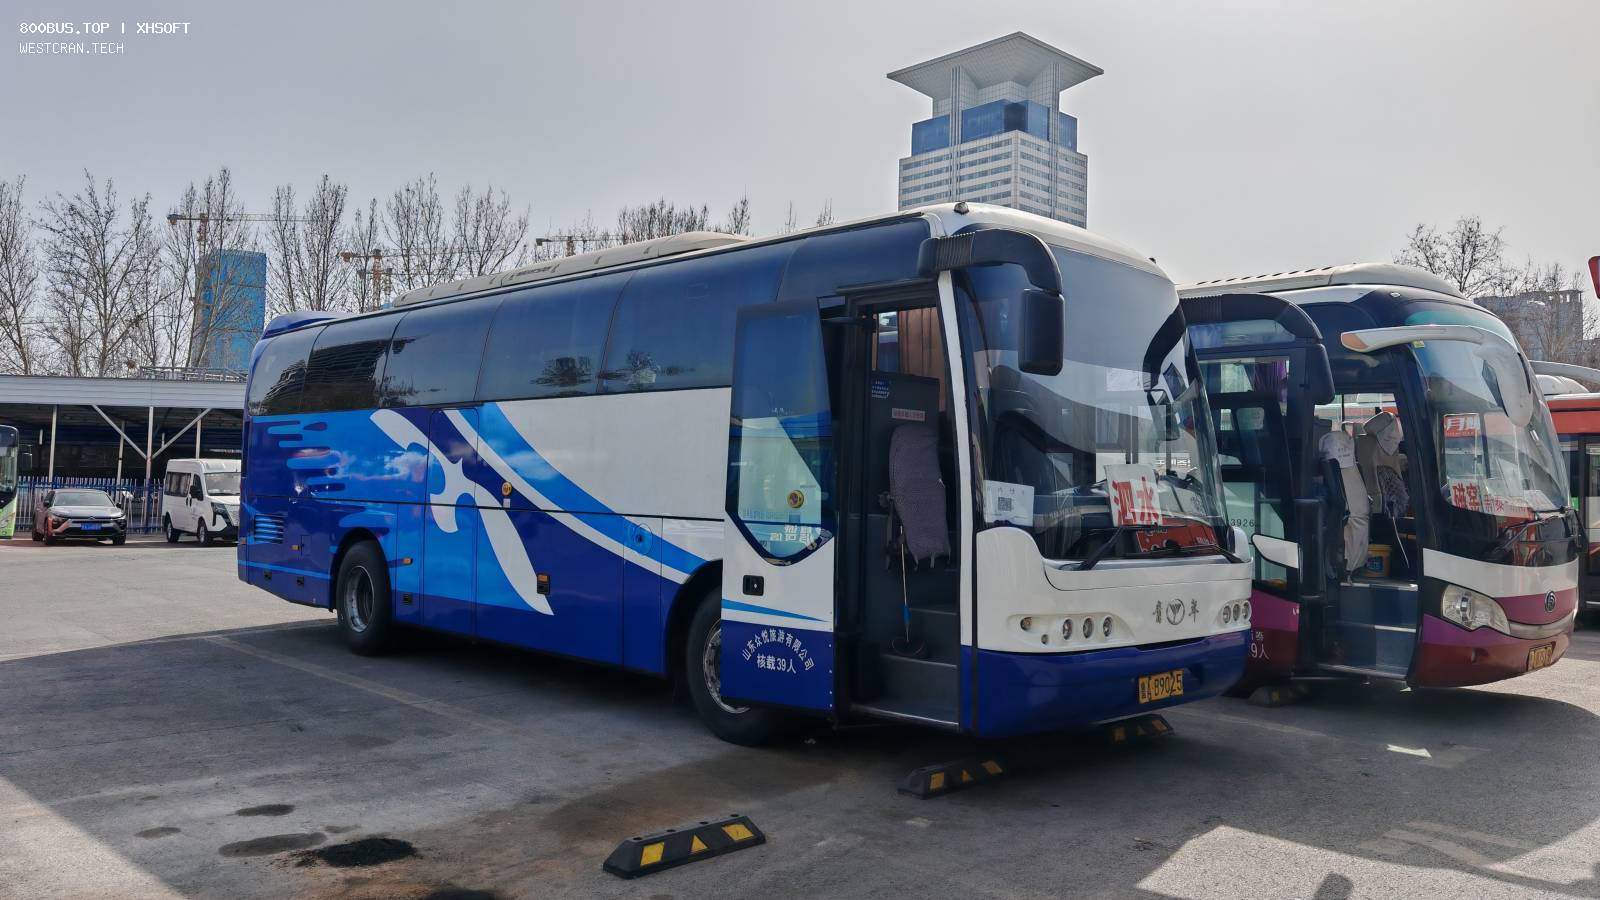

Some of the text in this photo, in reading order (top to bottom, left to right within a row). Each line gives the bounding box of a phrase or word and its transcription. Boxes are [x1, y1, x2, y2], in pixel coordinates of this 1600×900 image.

[1112, 476, 1159, 527] 泗水
[756, 652, 797, 674] 核载39人
